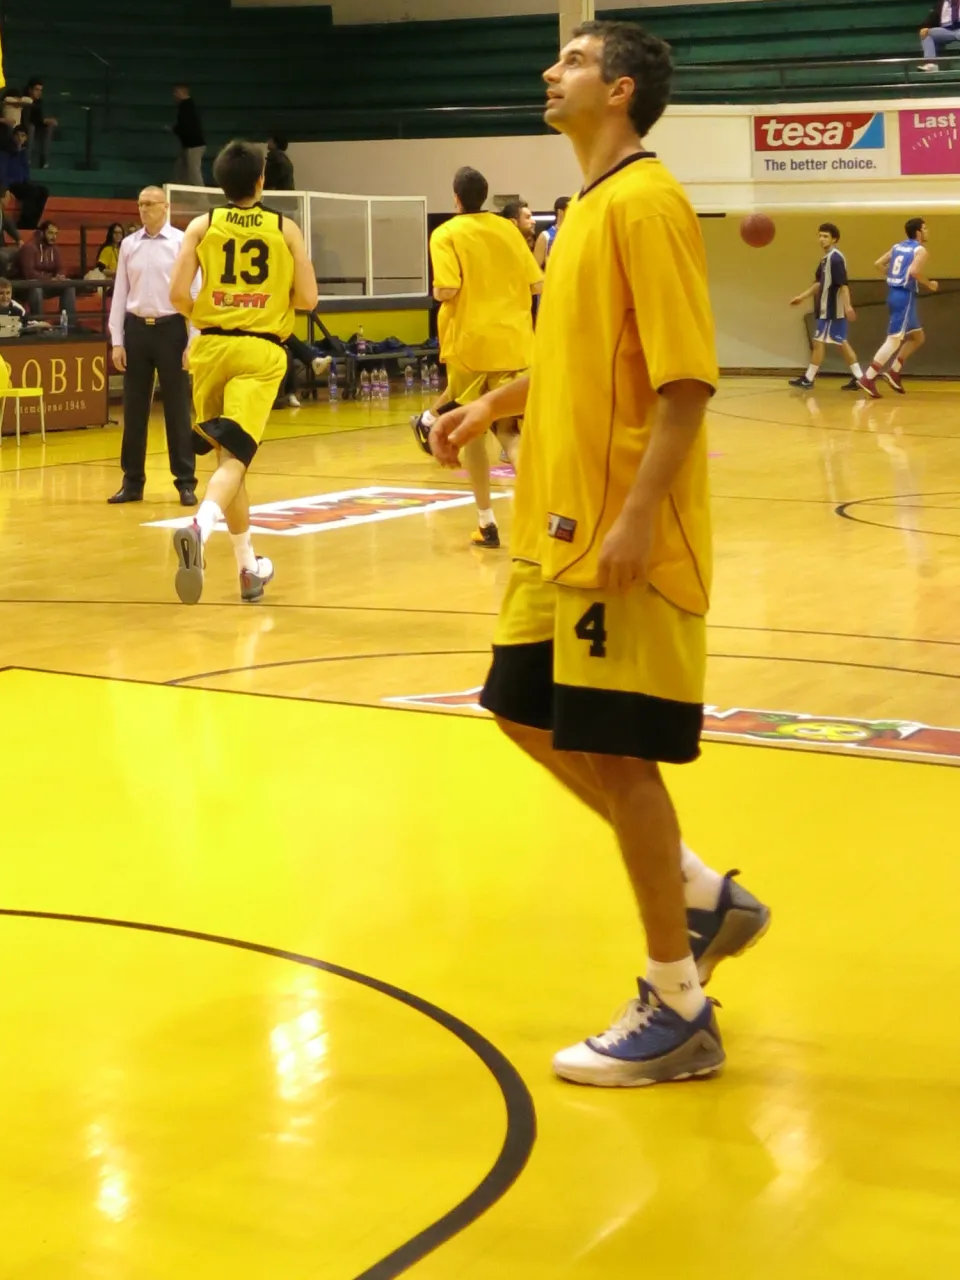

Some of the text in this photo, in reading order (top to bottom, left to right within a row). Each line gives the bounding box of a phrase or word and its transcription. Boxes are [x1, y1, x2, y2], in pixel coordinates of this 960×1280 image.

[914, 113, 957, 128] Last
[764, 154, 877, 171] The better choice.
[220, 238, 269, 285] 13
[891, 255, 904, 275] 6
[212, 291, 271, 309] TOMMY
[574, 602, 607, 658] 4
